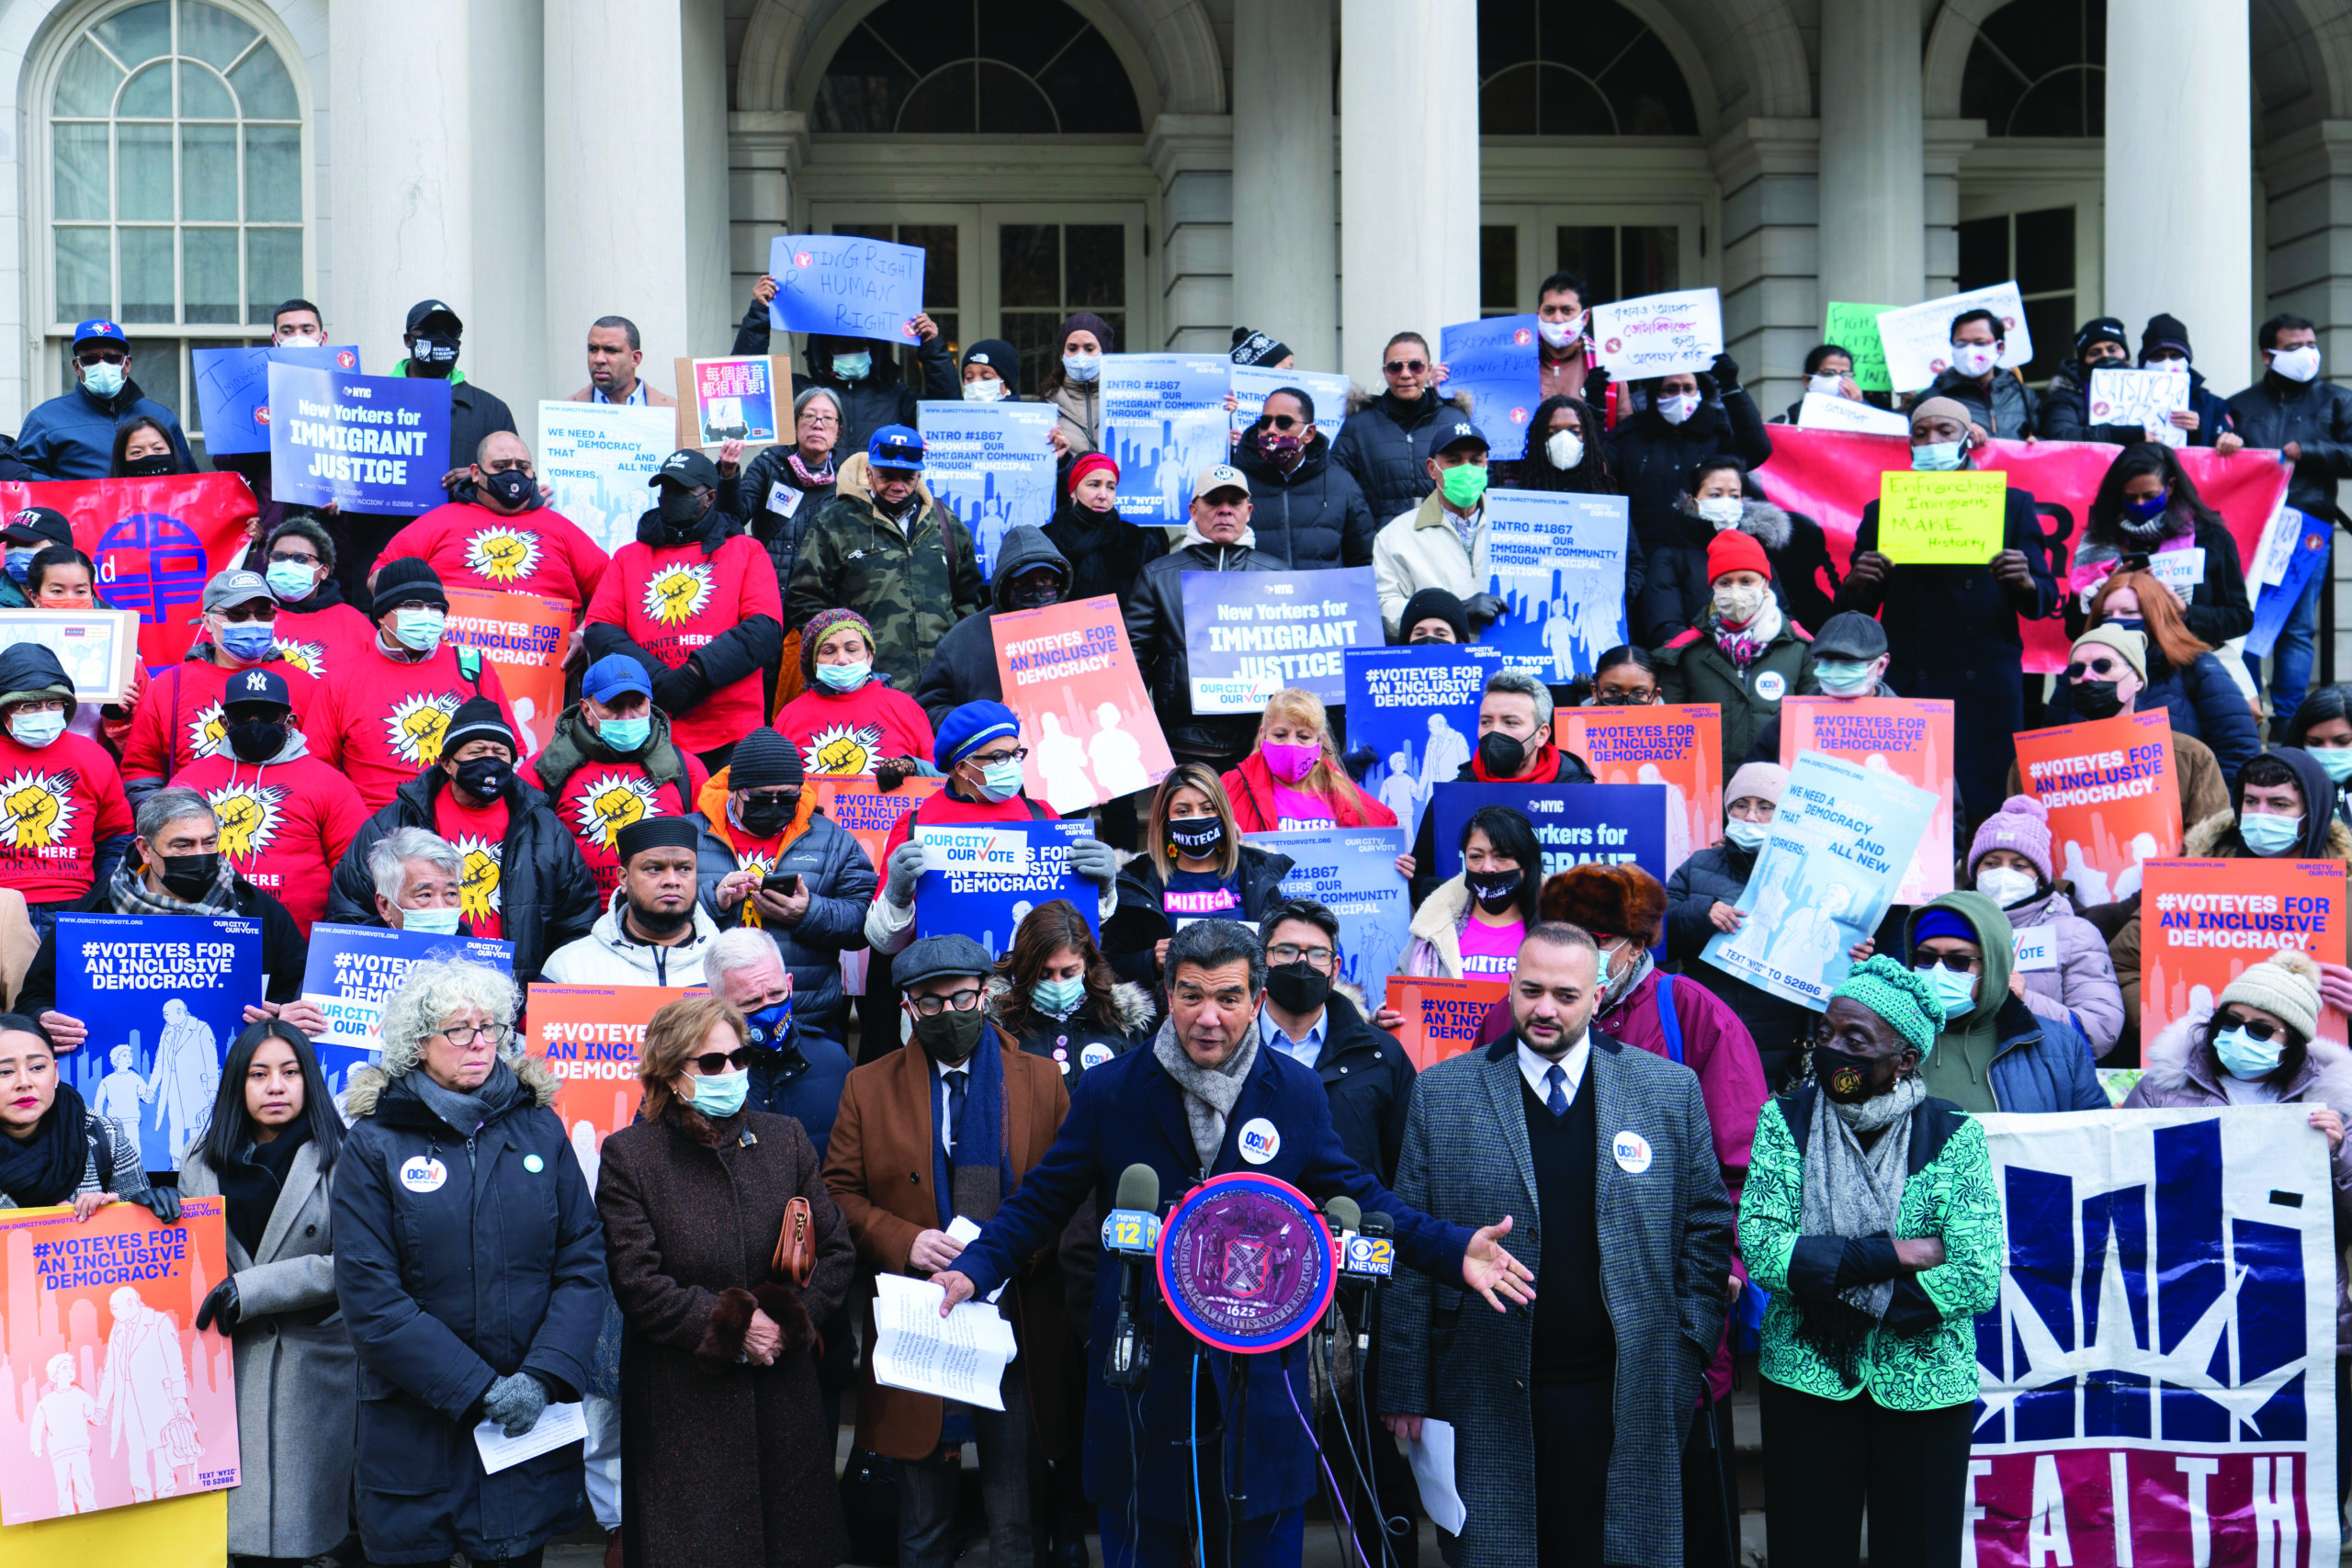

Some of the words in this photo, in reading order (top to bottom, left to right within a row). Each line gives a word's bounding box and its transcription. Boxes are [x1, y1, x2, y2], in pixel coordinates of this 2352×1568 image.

[782, 239, 858, 268] VTING
[821, 274, 896, 302] HUMAN
[835, 304, 899, 331] RIGHT
[706, 365, 764, 381] 每個語音
[1144, 381, 1181, 389] #1867
[353, 388, 371, 398] NYIC
[1106, 400, 1162, 409] IMMIGRANT
[299, 400, 330, 418] New
[334, 404, 393, 424] Yorkers
[397, 409, 421, 425] for
[290, 419, 427, 456] IMMIGRANT
[548, 428, 564, 436] WE
[568, 429, 594, 439] NEED
[926, 432, 961, 440] INTRO
[965, 432, 1002, 440] #1867
[578, 441, 641, 451] DEMOCRACY
[548, 448, 575, 457] THAT
[635, 454, 656, 462] AND
[926, 452, 984, 460] IMMIGRANT
[987, 453, 1047, 461] COMMUNITY
[309, 453, 407, 484] JUSTICE
[548, 468, 599, 479] YORKERS.
[617, 463, 637, 471] ALL
[975, 462, 1033, 471] MUNICIPAL
[1492, 521, 1529, 532] INTRO
[1533, 523, 1573, 535] #1867
[1893, 517, 1962, 532] MAKE
[1553, 536, 1574, 546] OUR
[1490, 544, 1552, 556] IMMIGRANT
[1555, 547, 1618, 558] COMMUNITY
[1490, 555, 1539, 565] THROUGH
[1541, 558, 1601, 570] MUNICIPAL
[1217, 604, 1253, 621] New
[1256, 603, 1319, 620] Yorkers
[1322, 600, 1348, 617] for
[533, 625, 560, 640] FOR
[1209, 621, 1357, 652] IMMIGRANT
[447, 630, 465, 644] AN
[469, 632, 557, 653] INCLUSIVE
[246, 671, 267, 691] NY
[1366, 667, 1448, 682] #VOTEYES
[1452, 666, 1483, 679] FOR
[1201, 684, 1223, 693] OUR
[1226, 684, 1252, 693] CITY
[1369, 681, 1391, 694] AN
[1395, 680, 1480, 694] INCLUSIVE
[1220, 694, 1243, 704] OUR
[1374, 693, 1475, 707] DEMOCRACY.
[1814, 716, 1892, 728] #VOTEYES
[1897, 718, 1926, 728] FOR
[1586, 726, 1662, 739] #VOTEYES
[1667, 725, 1695, 736] FOR
[1815, 727, 1835, 738] AN
[1840, 728, 1923, 740] INCLUSIVE
[1589, 739, 1610, 750] AN
[1612, 737, 1692, 749] INCLUSIVE
[1820, 739, 1917, 752] DEMOCRACY.
[1594, 750, 1687, 761] DEMOCRACY.
[2030, 750, 2124, 778] #VOTEYES
[2129, 743, 2164, 762] FOR
[2036, 776, 2055, 794] AN
[2060, 760, 2164, 791] INCLUSIVE
[834, 795, 910, 807] #VOTEYES
[1790, 784, 1803, 796] WE
[1804, 789, 1826, 804] NEED
[836, 807, 856, 818] AN
[1540, 800, 1564, 813] NYIC
[1780, 810, 1800, 825] THAT
[923, 834, 953, 846] OUR
[956, 836, 989, 848] CITY
[1172, 827, 1221, 846] MIXTECA
[0, 847, 81, 859] NITEHERE!
[947, 849, 976, 861] OUR
[58, 861, 78, 870] 100
[1291, 866, 1339, 880] #1867
[1316, 880, 1342, 891] OUR
[1167, 889, 1234, 910] MIXTECA
[1320, 889, 1398, 903] COMMUNITY
[1488, 890, 1506, 898] HOME
[2155, 893, 2278, 913] #VOTEYES
[2285, 897, 2330, 914] FOR
[59, 917, 143, 925] WWW.OURCITYOURVOTE.ORG
[2160, 912, 2190, 928] AN
[2198, 912, 2326, 932] INCLUSIVE
[82, 942, 190, 958] #VOTEYES
[197, 942, 235, 958] FOR
[85, 958, 113, 974] AN
[119, 958, 232, 974] INCLUSIVE
[1462, 954, 1517, 973] MIXTEC
[334, 969, 364, 986] AN
[1768, 967, 1781, 981] TO
[1423, 1012, 1445, 1025] AN
[1246, 1131, 1275, 1152] OCOV
[1617, 1143, 1642, 1158] OCOV
[1116, 1214, 1142, 1223] news
[1115, 1223, 1140, 1245] 12
[1148, 1227, 1156, 1249] 12
[33, 1233, 142, 1258] #VOTEYES
[149, 1227, 187, 1245] FOR
[1371, 1240, 1391, 1263] 2
[38, 1258, 65, 1274] AN
[73, 1245, 186, 1271] INCLUSIVE
[1350, 1260, 1389, 1273] NEWS
[1227, 1305, 1256, 1317] 1625
[198, 1472, 214, 1480] TEXT
[213, 1476, 233, 1484] 52886
[1962, 1452, 2298, 1568] FAITH
